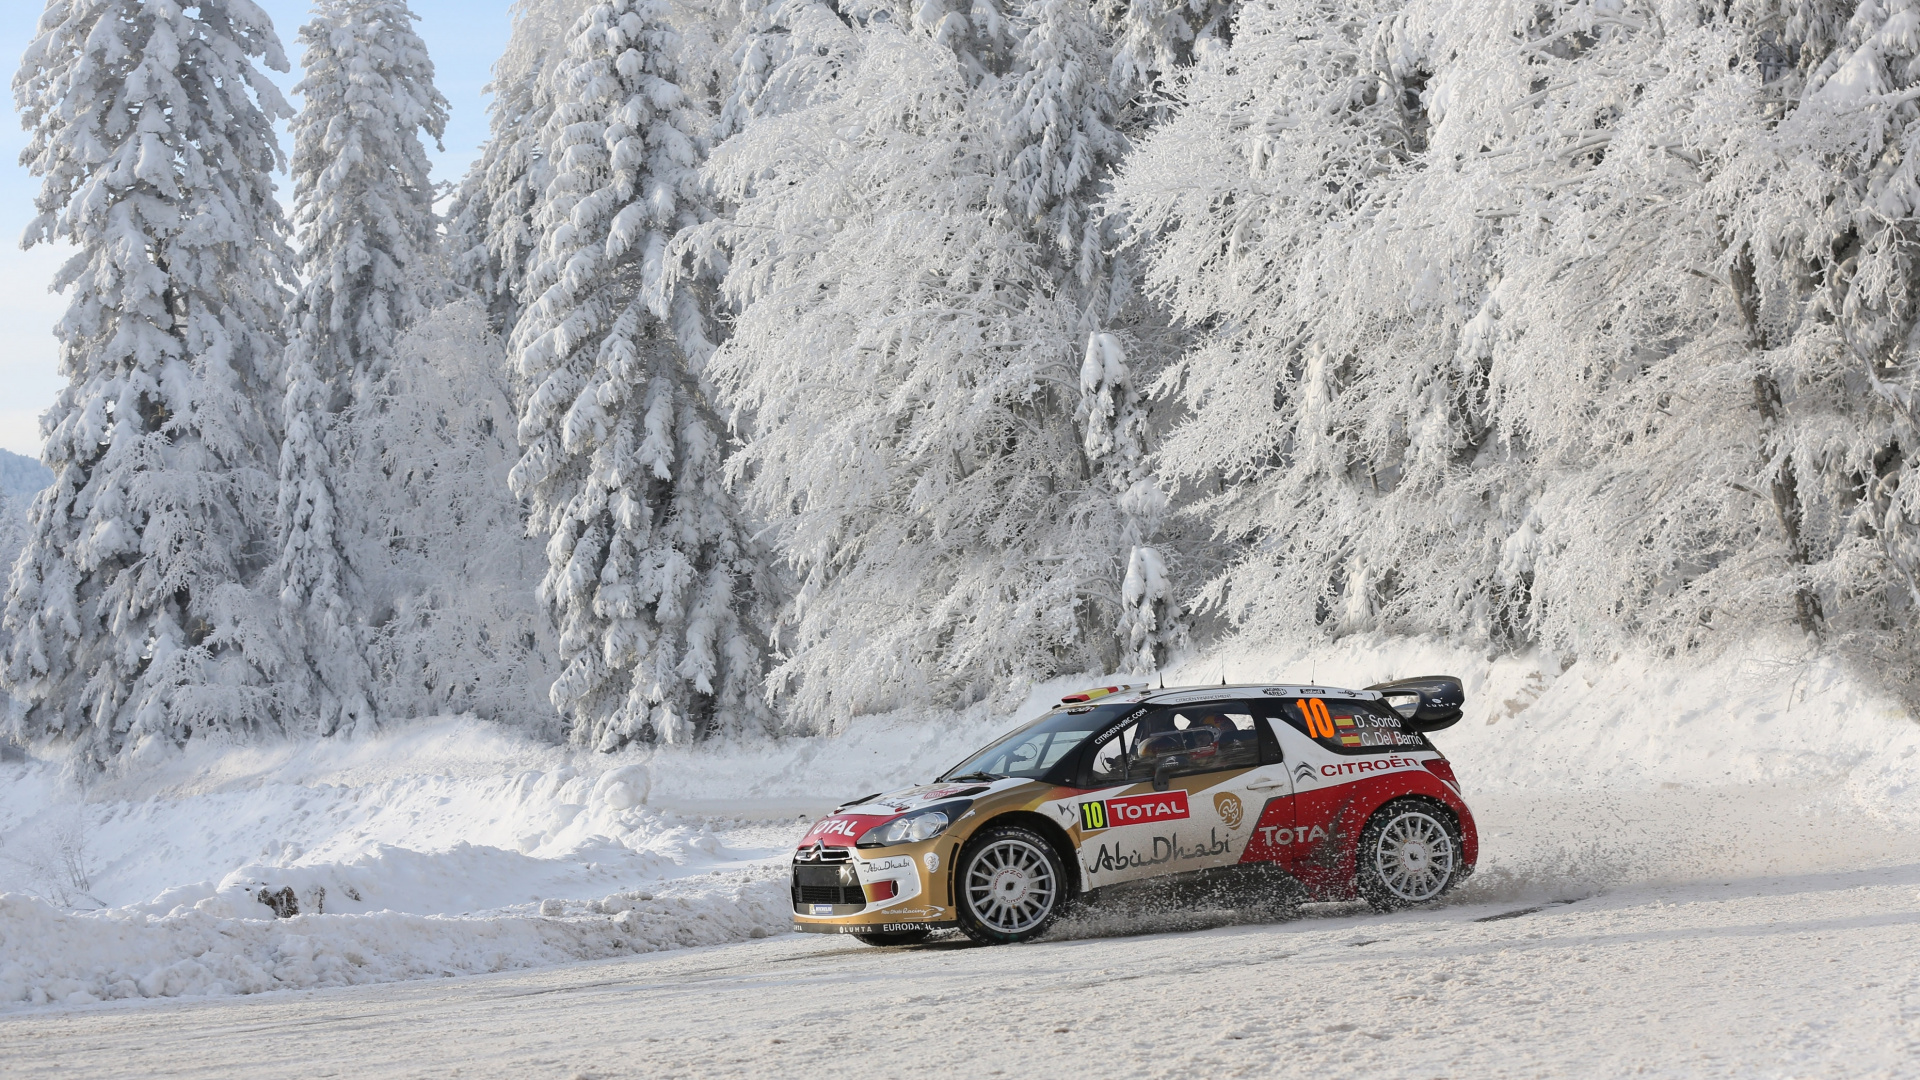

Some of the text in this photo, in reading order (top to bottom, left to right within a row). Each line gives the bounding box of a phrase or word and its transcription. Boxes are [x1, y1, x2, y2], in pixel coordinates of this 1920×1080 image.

[1296, 697, 1335, 739] 10
[1354, 714, 1402, 729] D. Sordo
[1361, 731, 1423, 746] C. Del Barrio
[1320, 755, 1420, 777] CITROËN
[1082, 801, 1104, 829] 10
[1111, 801, 1185, 820] TOTAL
[1089, 827, 1231, 874] Abu Dhabi
